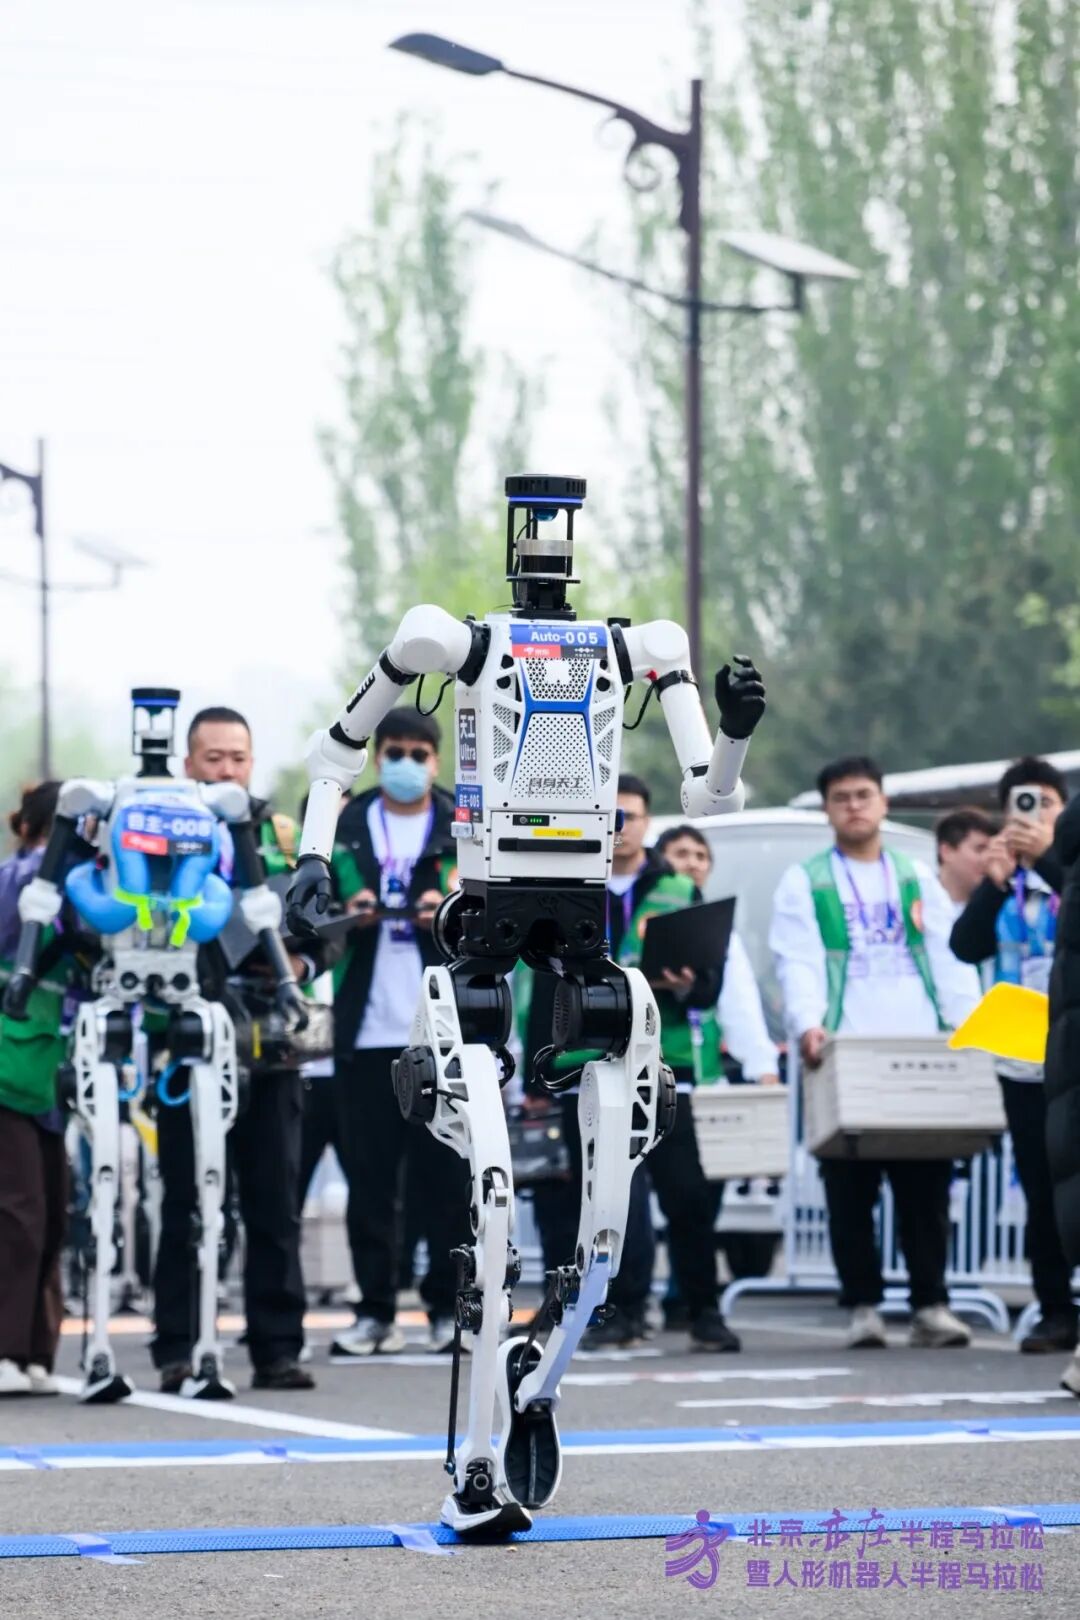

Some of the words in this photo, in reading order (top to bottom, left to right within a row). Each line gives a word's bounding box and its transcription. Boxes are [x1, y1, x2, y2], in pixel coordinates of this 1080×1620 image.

[530, 631, 599, 645] Auto-005
[460, 714, 476, 740] 天工
[460, 743, 476, 761] Ultra
[528, 777, 584, 790] 具身天工
